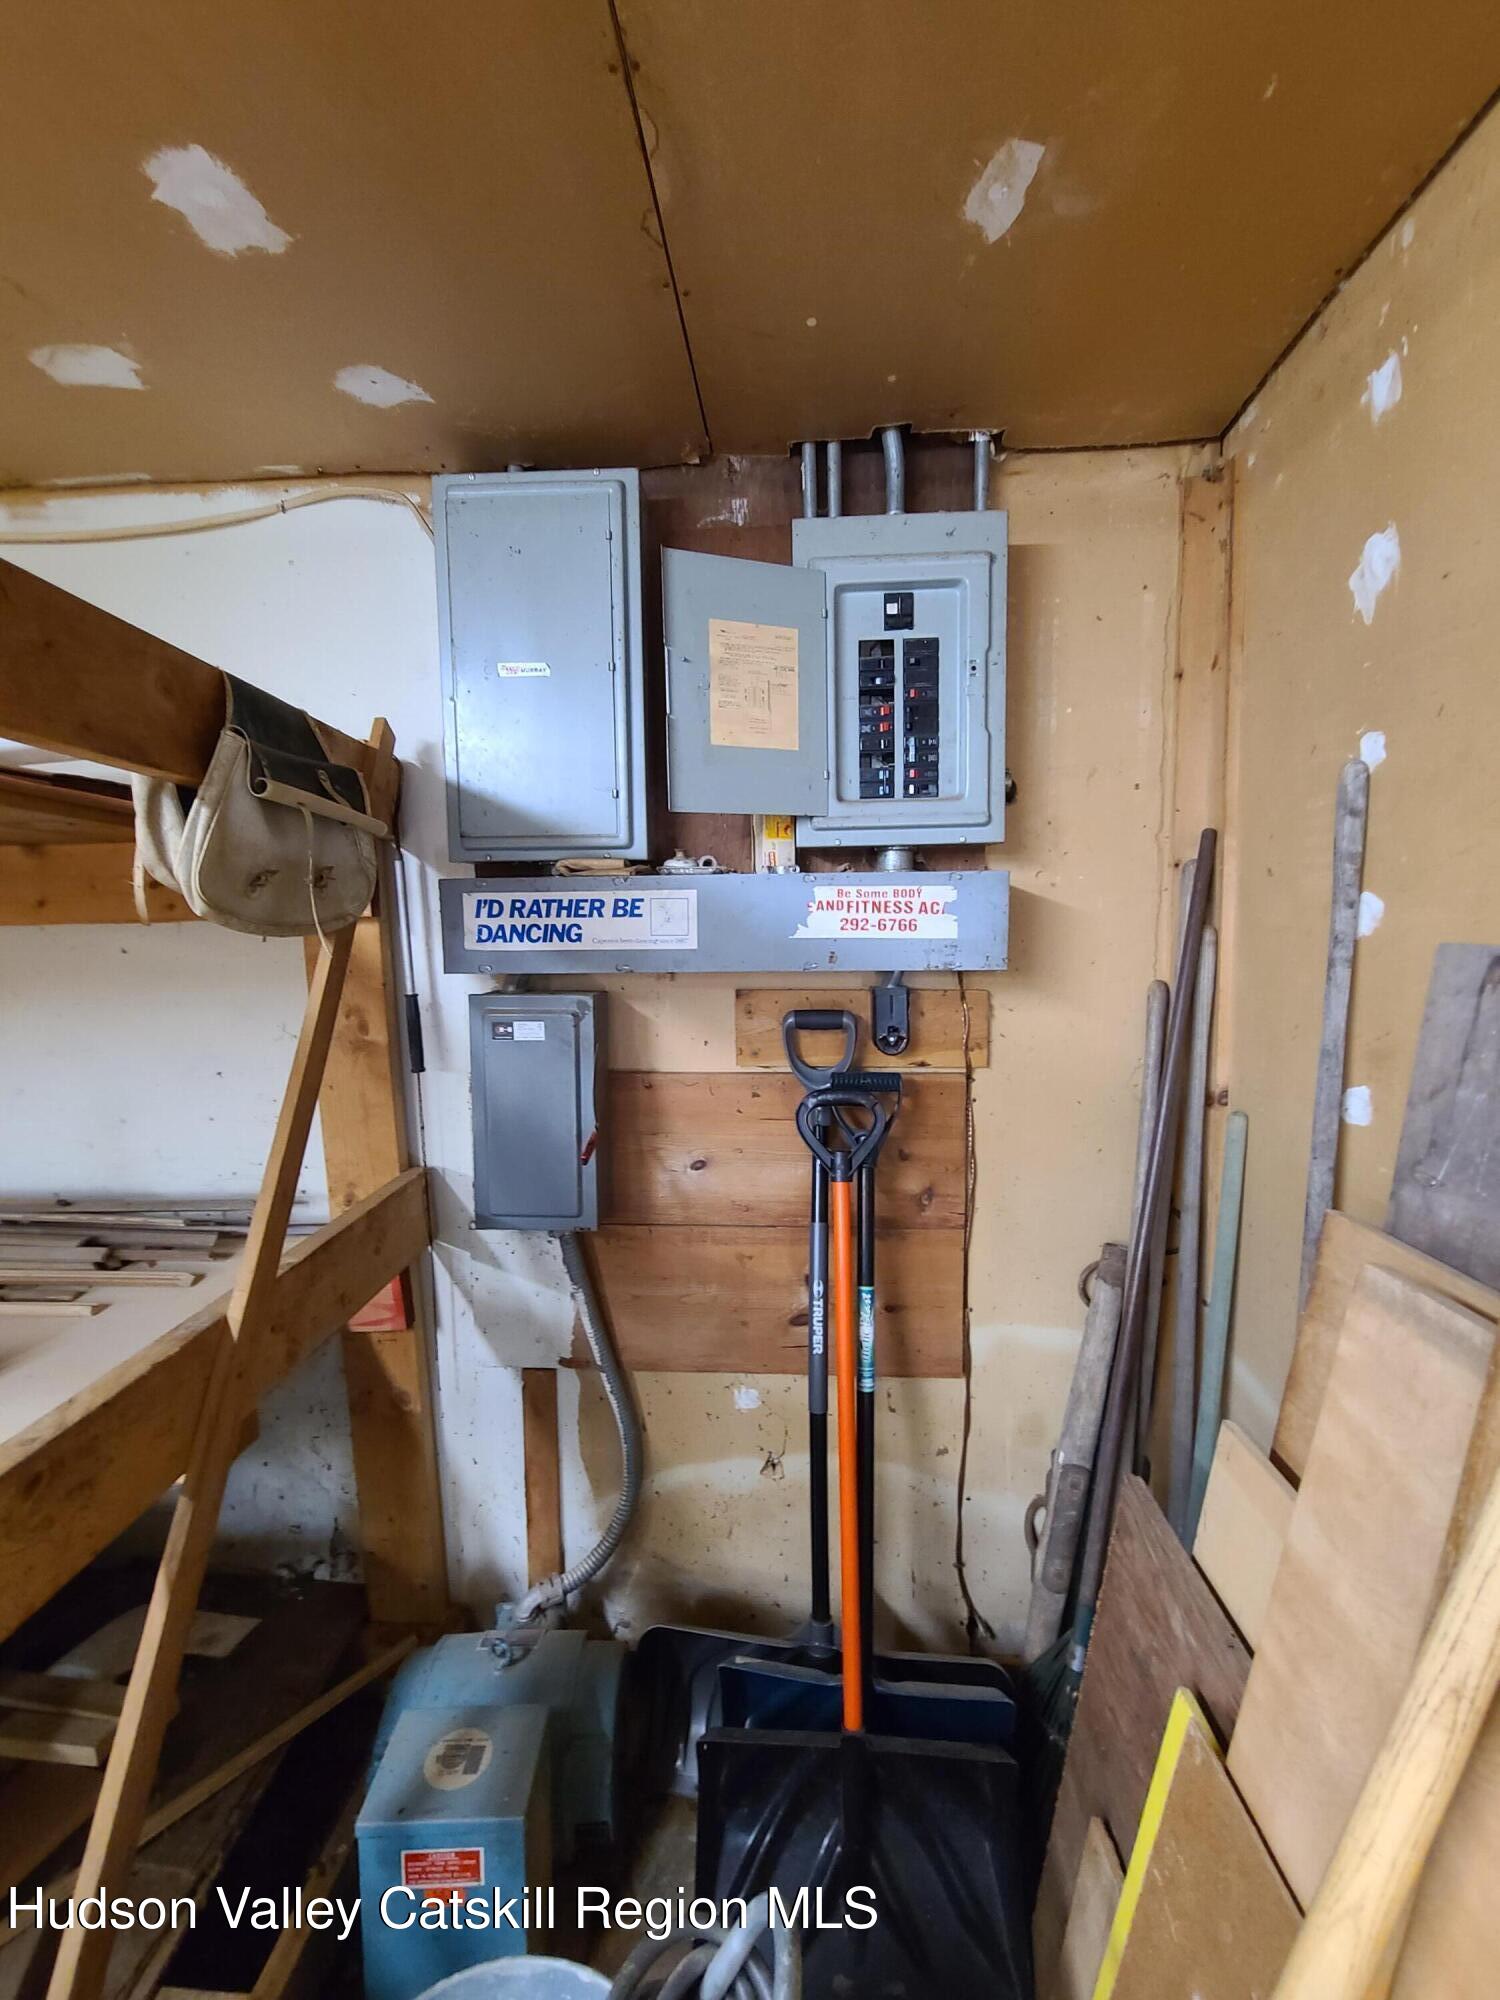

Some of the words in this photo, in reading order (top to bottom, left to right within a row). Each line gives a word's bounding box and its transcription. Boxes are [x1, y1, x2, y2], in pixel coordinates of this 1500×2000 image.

[837, 888, 852, 898] Be
[856, 888, 888, 898] Some
[893, 887, 922, 899] BODY
[475, 898, 504, 918] I'D
[509, 898, 605, 918] RATHER
[612, 898, 645, 918] BE
[847, 901, 914, 914] FITNESS
[839, 918, 918, 932] 292-6766
[476, 924, 583, 944] DANCING
[812, 1298, 824, 1355] TRUPER
